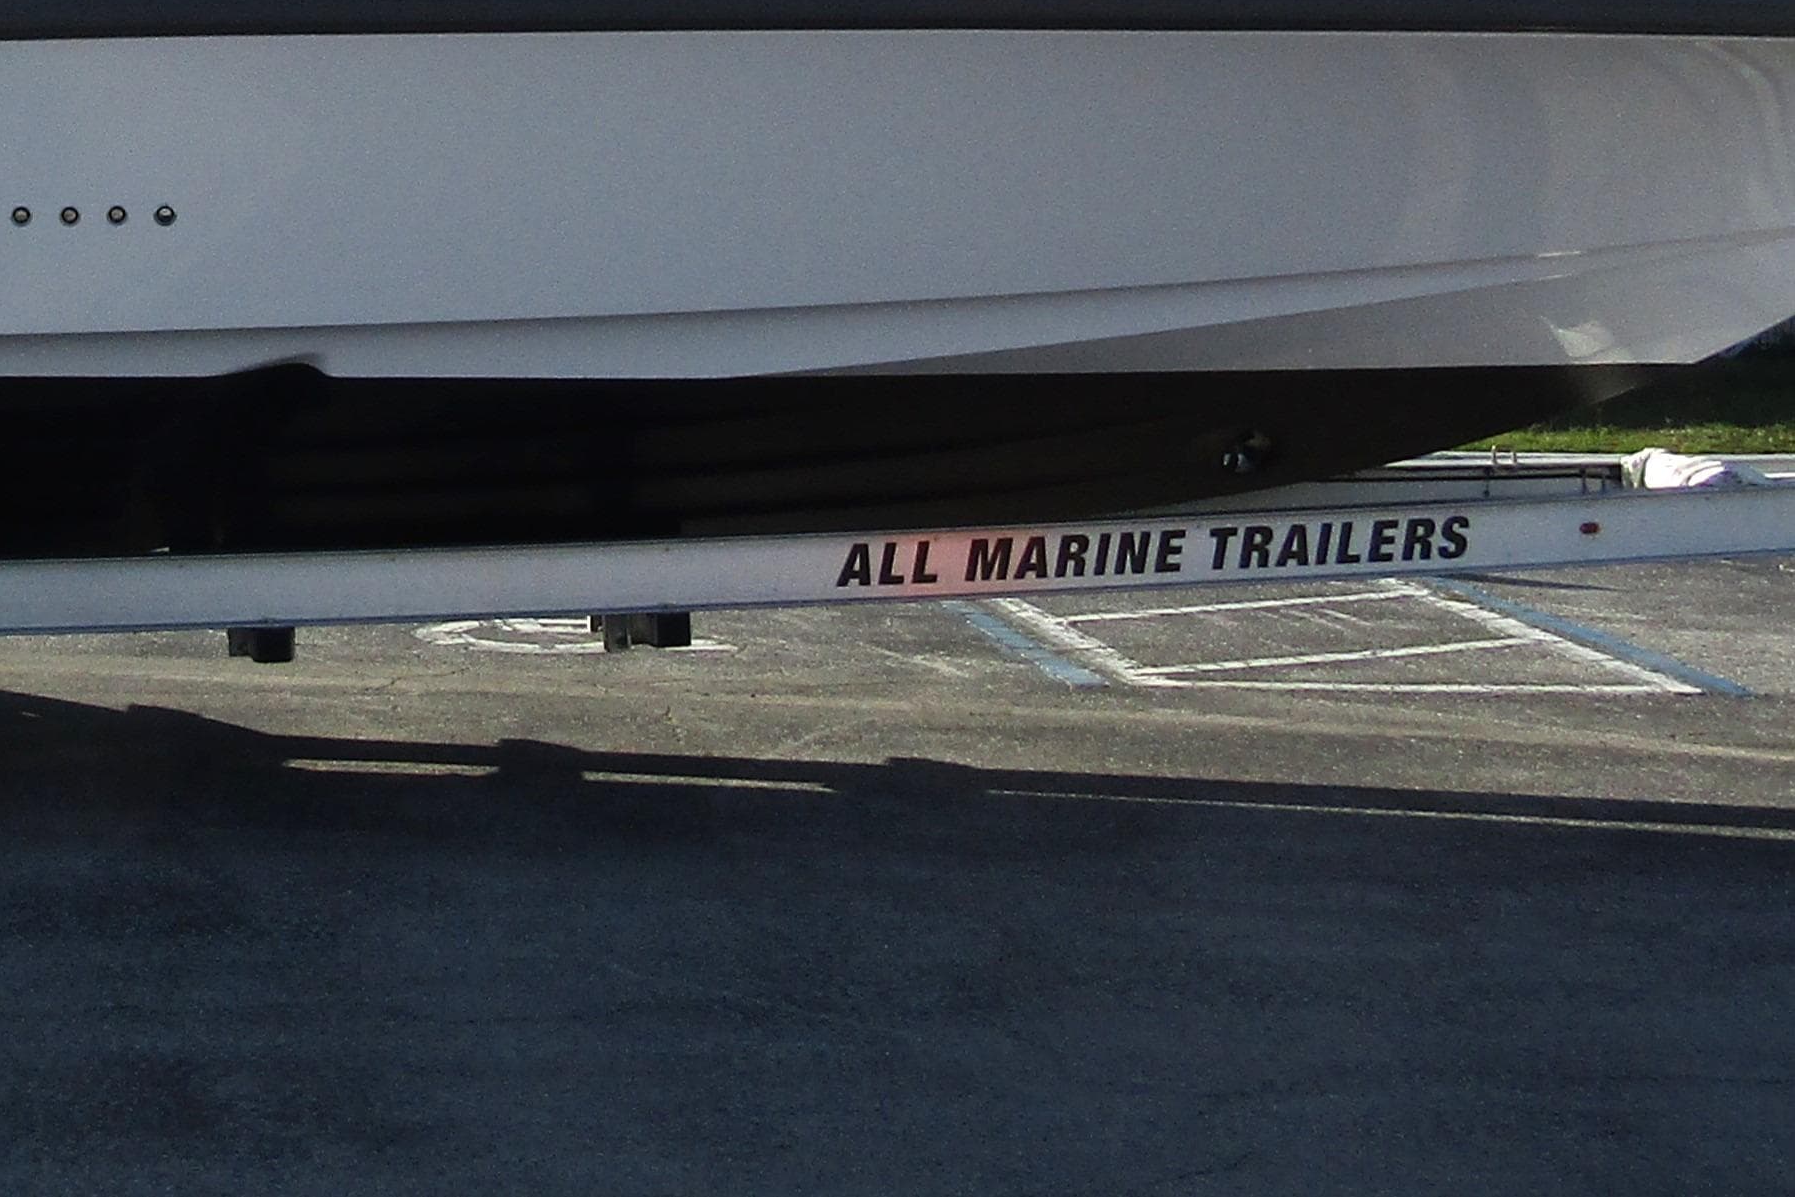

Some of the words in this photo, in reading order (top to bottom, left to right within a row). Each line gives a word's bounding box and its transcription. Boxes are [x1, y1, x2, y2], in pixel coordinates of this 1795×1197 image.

[836, 540, 939, 588] ALL
[964, 529, 1187, 583] MARINE
[1209, 515, 1470, 571] TRAILERS
